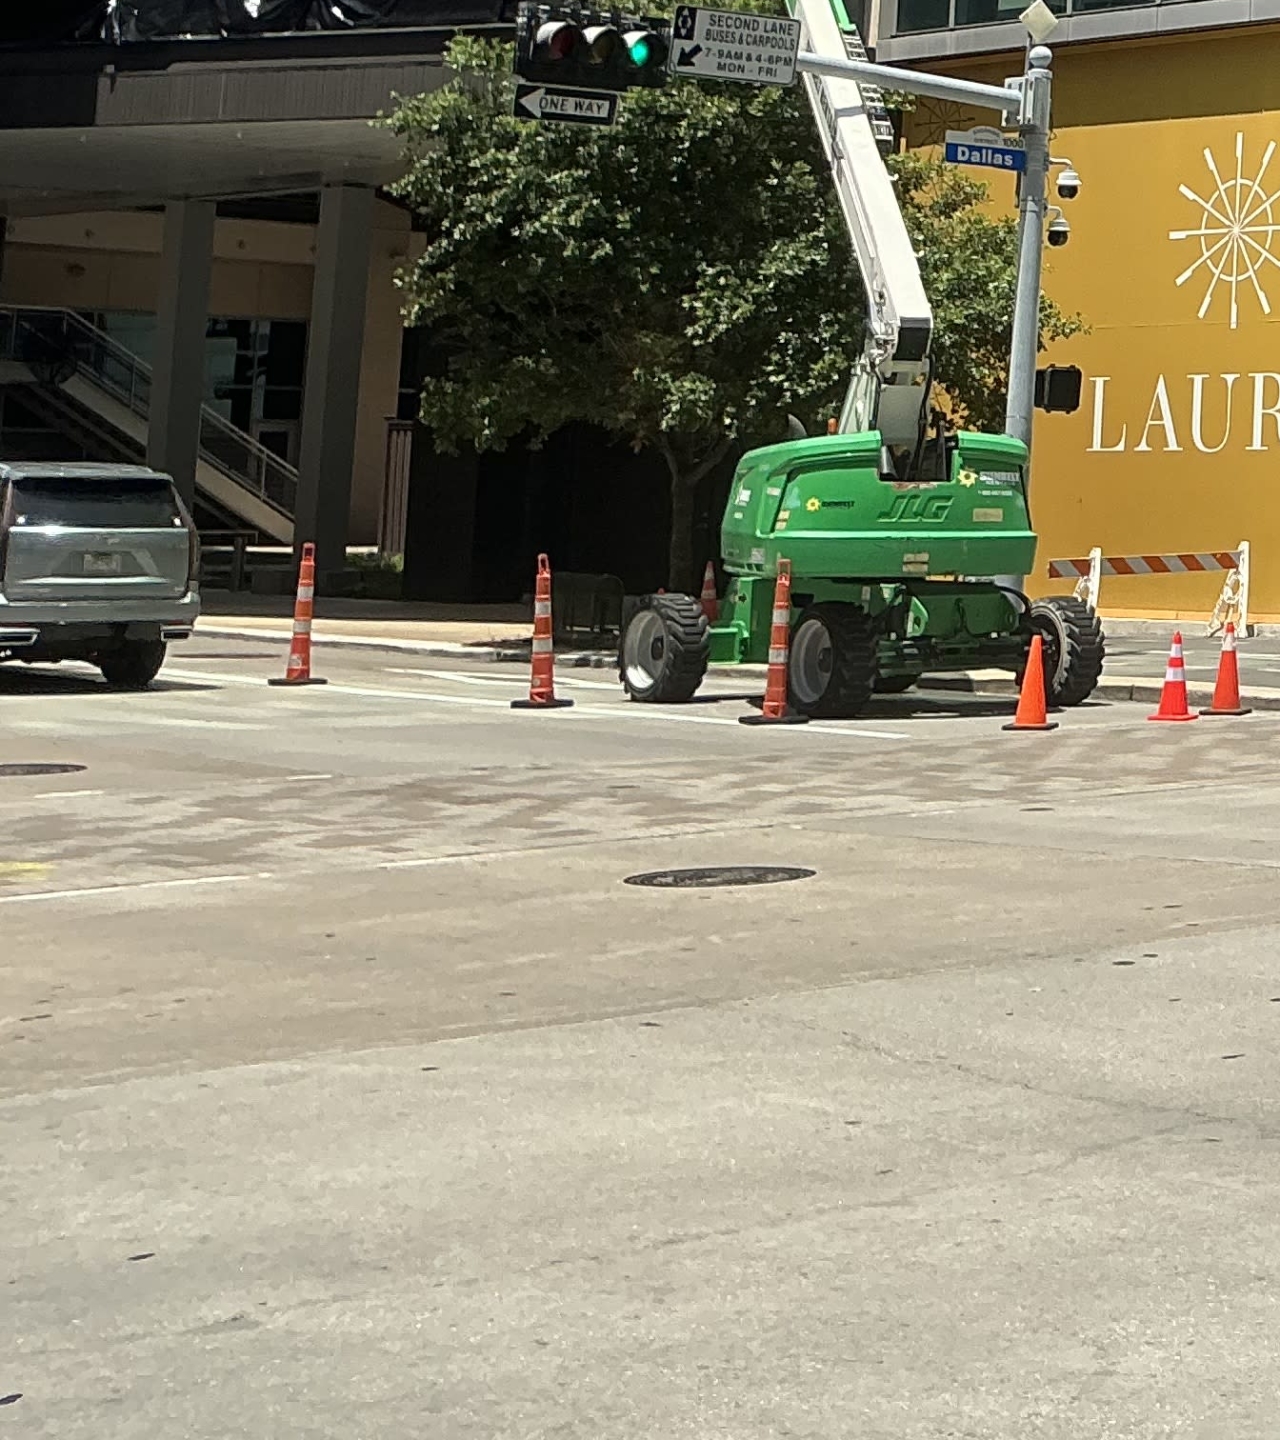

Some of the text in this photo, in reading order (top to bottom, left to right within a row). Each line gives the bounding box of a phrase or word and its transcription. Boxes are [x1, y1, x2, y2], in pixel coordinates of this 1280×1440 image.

[709, 14, 794, 35] SECOND LANE
[705, 28, 736, 44] BUSES
[746, 34, 795, 51] CARPOOLS
[716, 61, 745, 74] MON
[758, 66, 778, 78] FRI
[539, 97, 604, 114] ONE WAY
[957, 145, 1014, 166] Dallas
[877, 495, 954, 523] JLG
